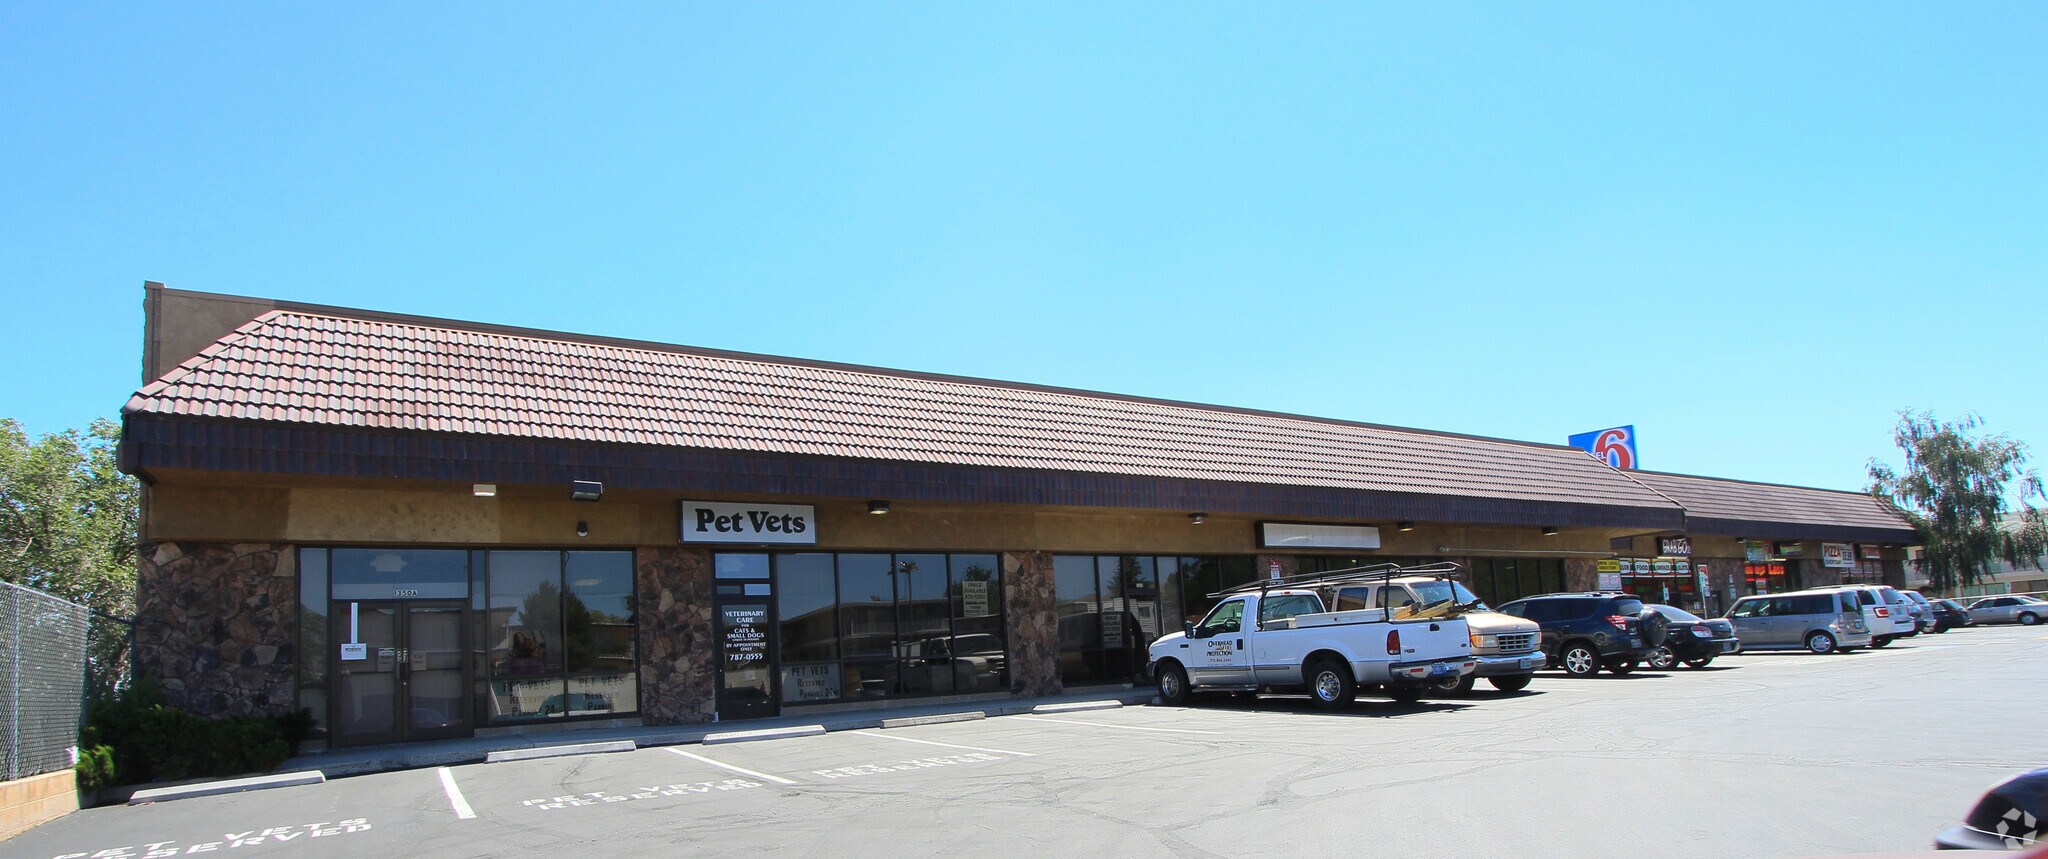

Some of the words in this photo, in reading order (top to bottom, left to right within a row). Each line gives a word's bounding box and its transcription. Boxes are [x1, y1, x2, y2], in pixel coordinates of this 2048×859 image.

[1595, 430, 1631, 469] 6
[695, 508, 743, 532] Pet
[747, 511, 806, 533] Vets
[1824, 545, 1840, 557] PIZZA
[730, 653, 763, 661] 787-0555
[579, 678, 596, 687] PET
[792, 666, 806, 676] PET
[810, 665, 829, 675] VETS
[522, 791, 605, 806] PET
[639, 779, 748, 792] VETS
[539, 782, 764, 810] RESERVED
[51, 841, 177, 859] PET
[225, 818, 367, 841] VETS
